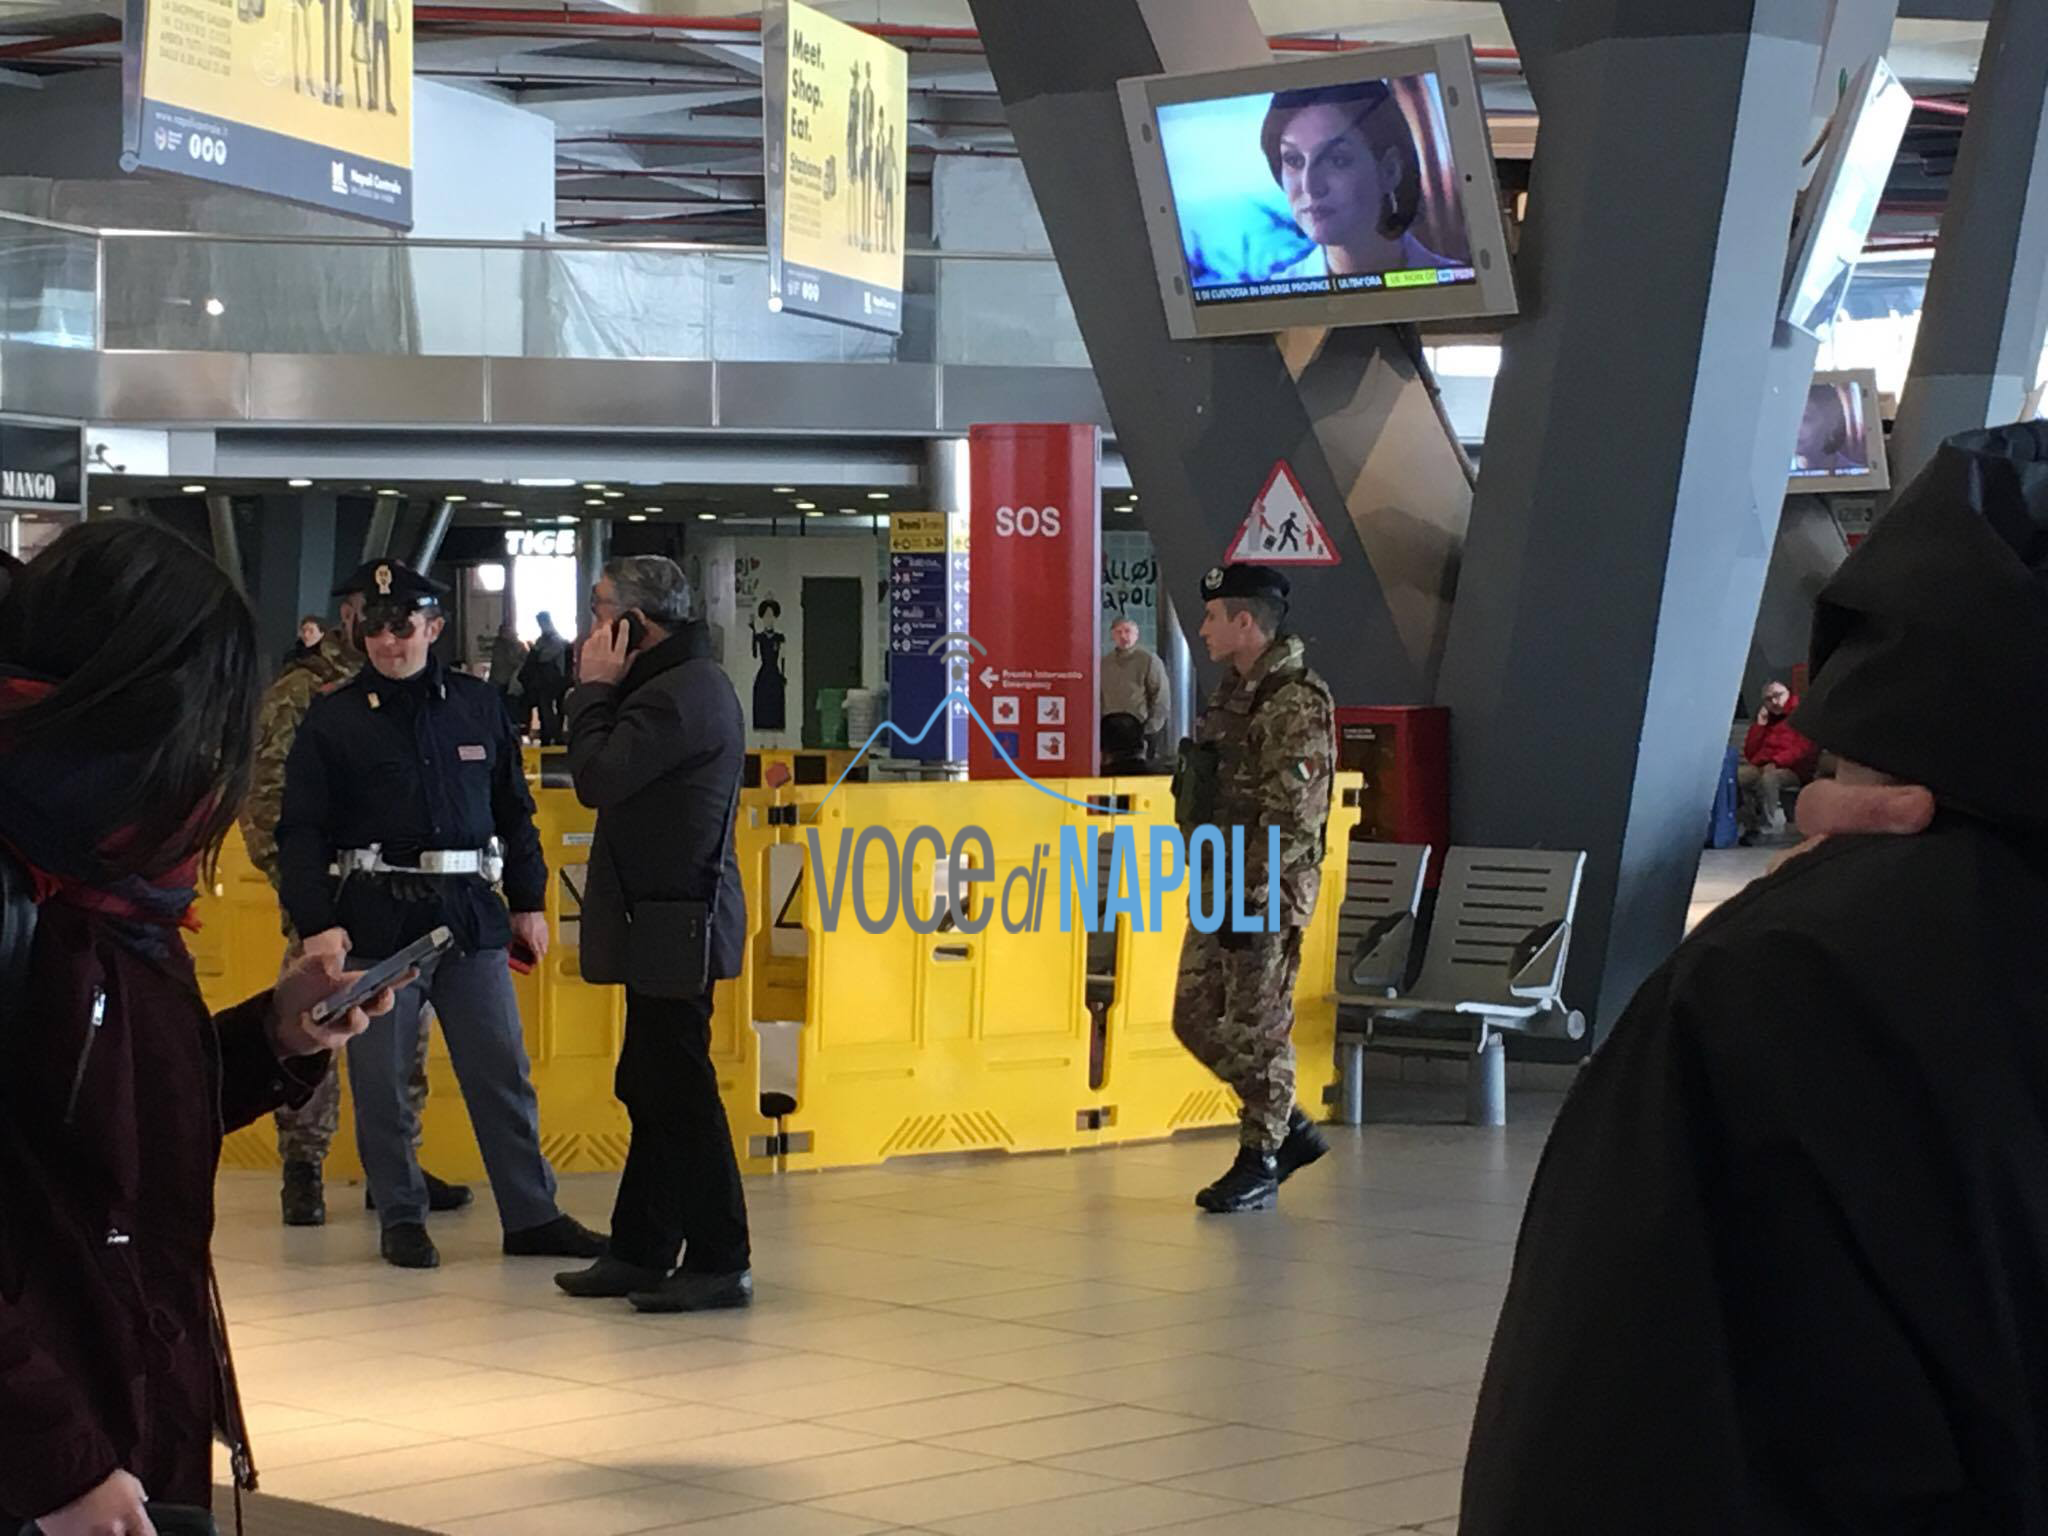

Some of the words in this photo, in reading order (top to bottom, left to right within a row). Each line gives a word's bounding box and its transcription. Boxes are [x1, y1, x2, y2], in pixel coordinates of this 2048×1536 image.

[792, 29, 824, 70] Meet.
[792, 68, 823, 114] Shop.
[791, 107, 812, 142] Eat.
[2, 470, 56, 500] MANGO
[996, 506, 1061, 537] SOS
